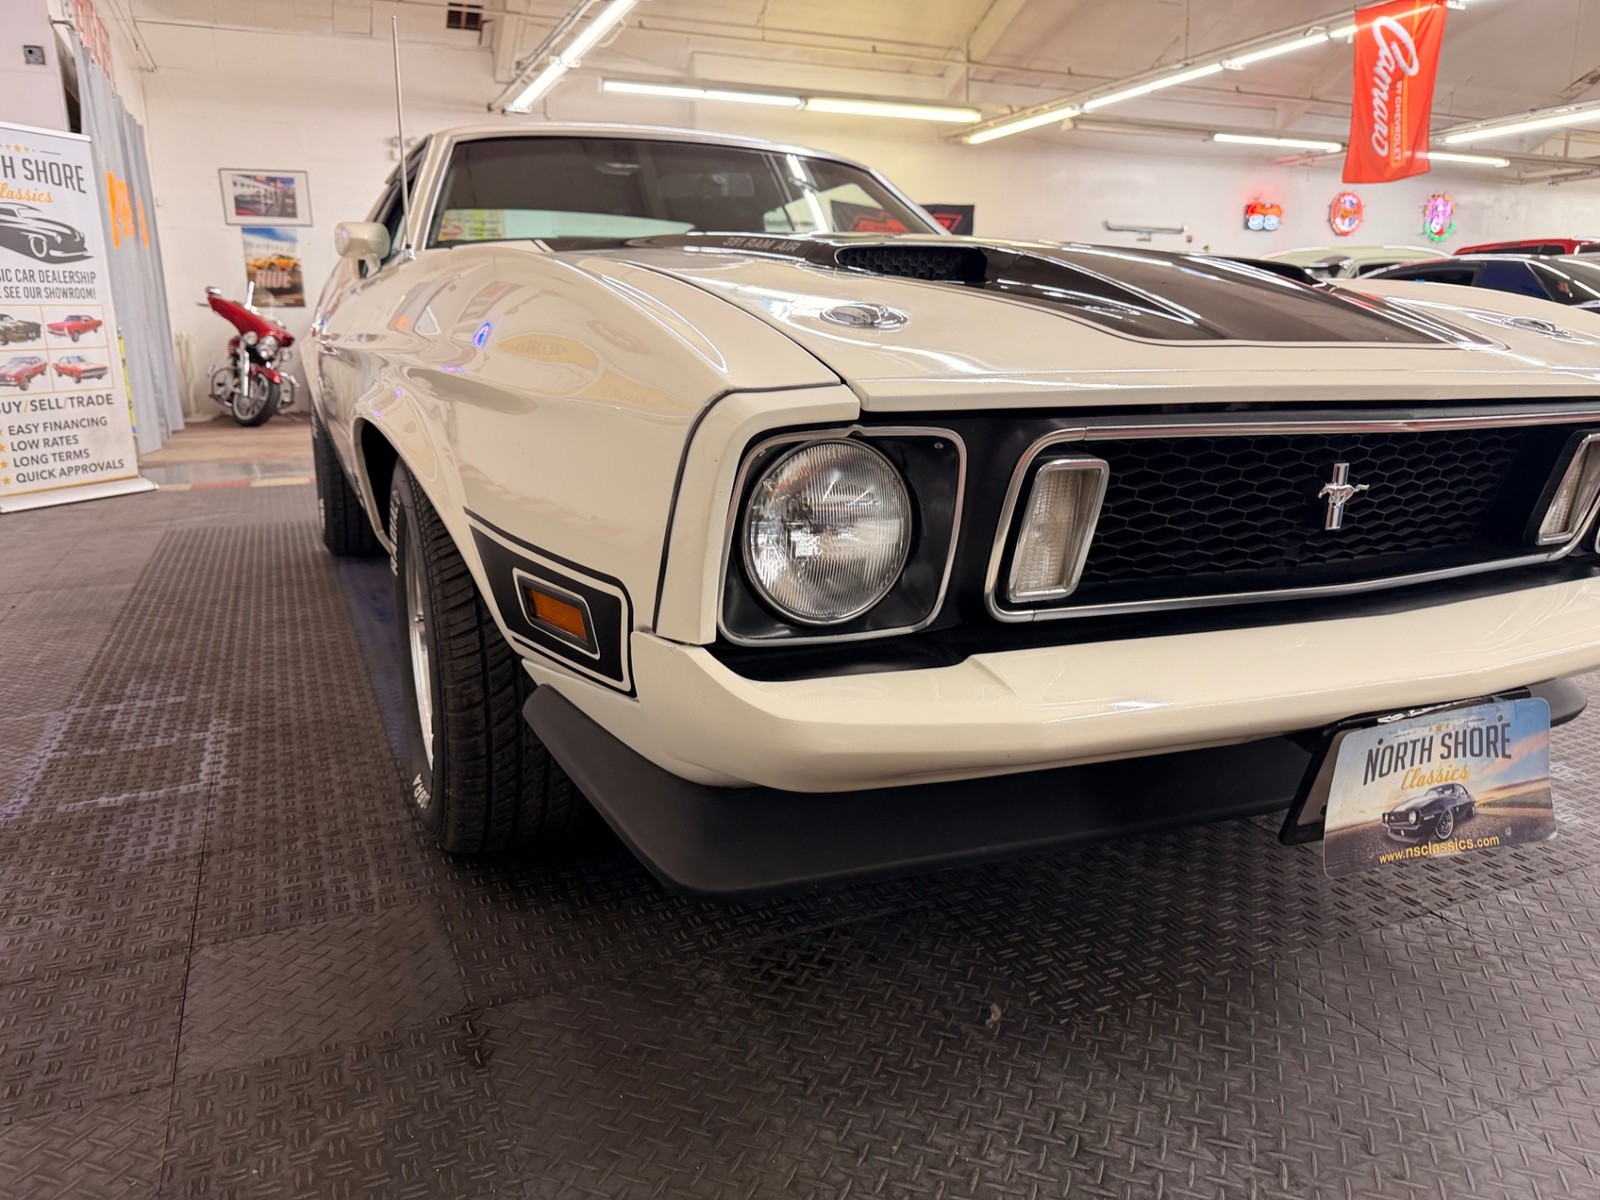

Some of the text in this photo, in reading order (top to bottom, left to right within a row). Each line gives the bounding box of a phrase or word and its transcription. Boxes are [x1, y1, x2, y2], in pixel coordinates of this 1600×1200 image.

[1371, 16, 1420, 157] Camaro
[1393, 95, 1403, 161] CHEVROLET
[22, 158, 87, 195] SHORE
[0, 182, 54, 204] lassics
[744, 237, 776, 249] RAM
[773, 241, 801, 252] AIR
[15, 268, 36, 283] CAR
[38, 269, 97, 284] DEALERSHIP
[3, 286, 21, 299] SEE
[23, 286, 42, 299] OUR
[44, 286, 97, 300] SHOWROOM!
[8, 416, 108, 436] EASY FINANCING
[10, 434, 79, 452] LOW RATES
[13, 448, 90, 468] LONG TERMS
[16, 458, 125, 484] QUICK APPROVALS
[1363, 722, 1512, 786] NORTH SHORE
[1400, 763, 1471, 791] Classics
[1379, 836, 1500, 864] www.nsclassics.com
